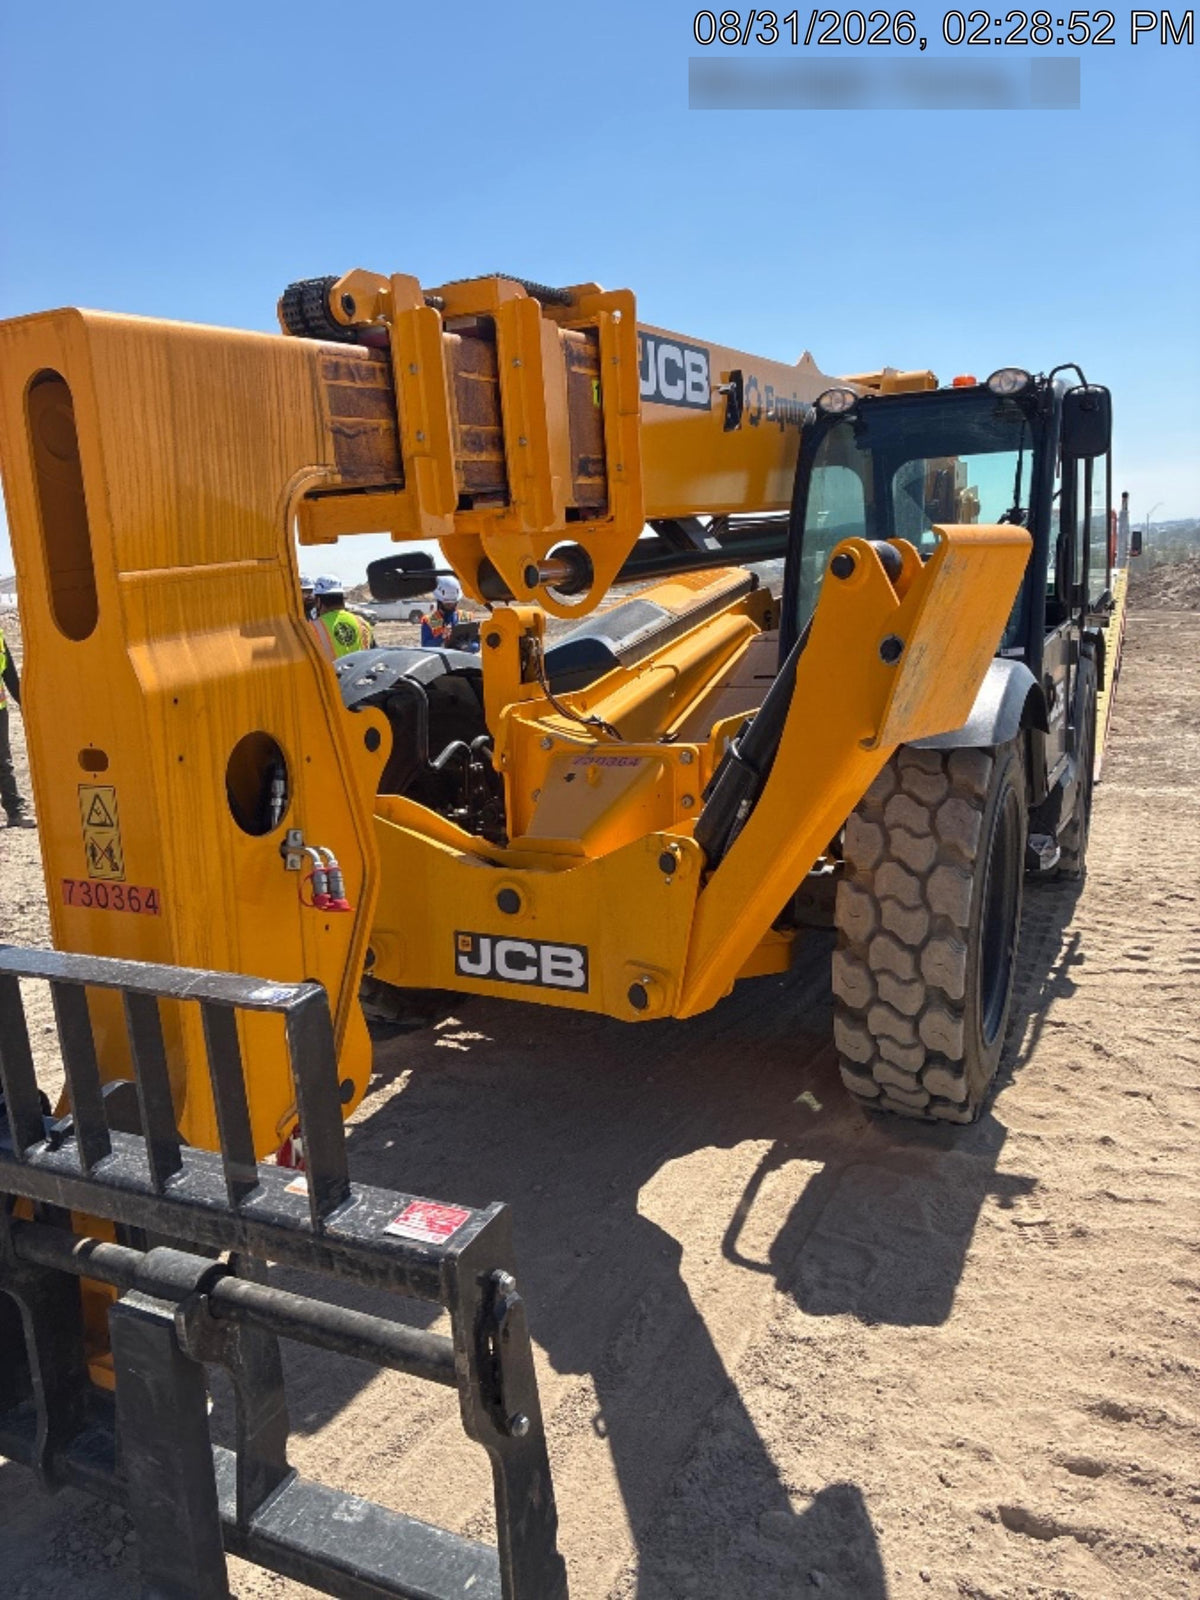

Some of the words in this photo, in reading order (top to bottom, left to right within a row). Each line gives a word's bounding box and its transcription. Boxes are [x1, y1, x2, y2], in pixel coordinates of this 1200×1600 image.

[640, 340, 709, 404] JCB
[765, 384, 812, 433] Equip
[63, 879, 159, 914] 730364
[458, 937, 585, 988] JCB
